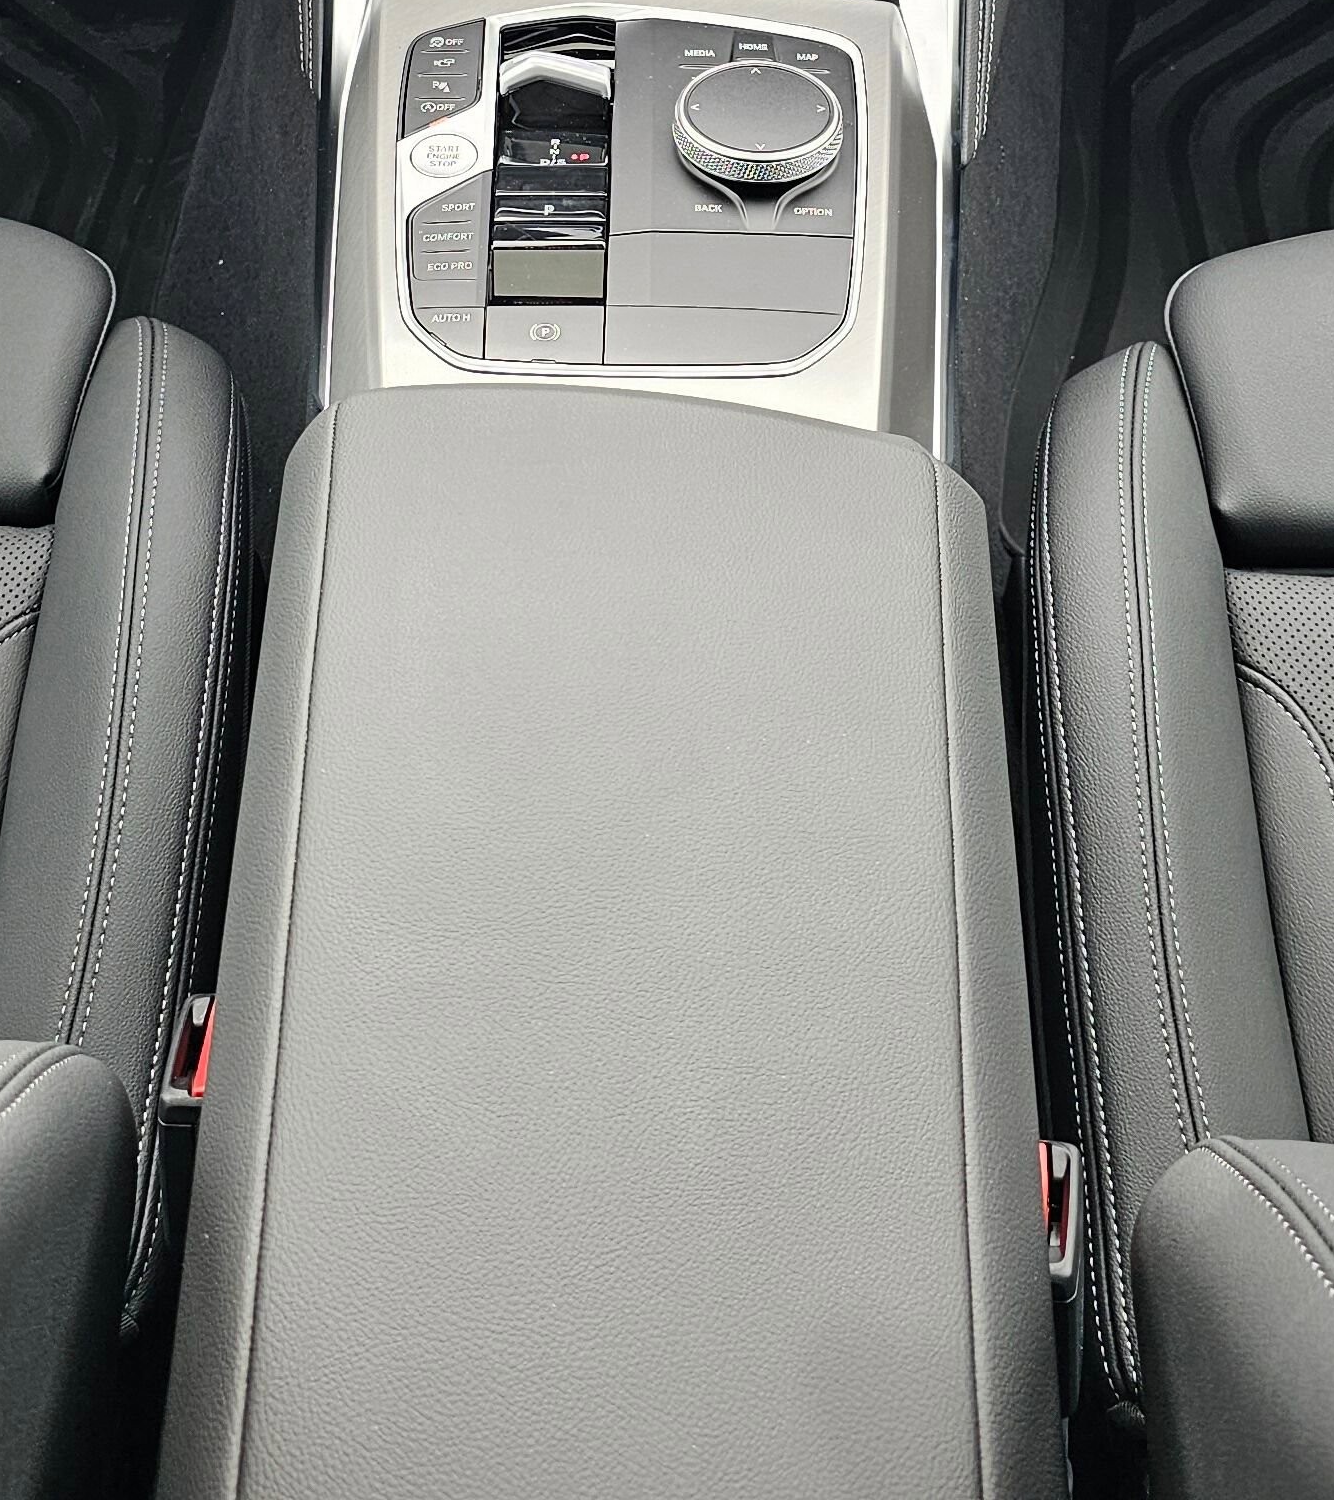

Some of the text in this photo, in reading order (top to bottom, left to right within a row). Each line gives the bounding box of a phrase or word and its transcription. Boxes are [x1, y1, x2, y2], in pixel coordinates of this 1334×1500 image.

[445, 38, 464, 46] OFF
[738, 42, 768, 51] HOME
[684, 49, 716, 58] MEDIA
[796, 53, 819, 62] MAP
[436, 103, 456, 111] OFF
[428, 145, 460, 153] START
[427, 152, 460, 160] ENGINE
[441, 202, 476, 212] SPORT
[544, 204, 555, 216] P
[694, 204, 723, 213] BACK
[793, 207, 833, 217] OPTION
[422, 232, 475, 242] COMFORT
[427, 261, 473, 271] ECO PRO
[431, 313, 471, 323] AUTO H
